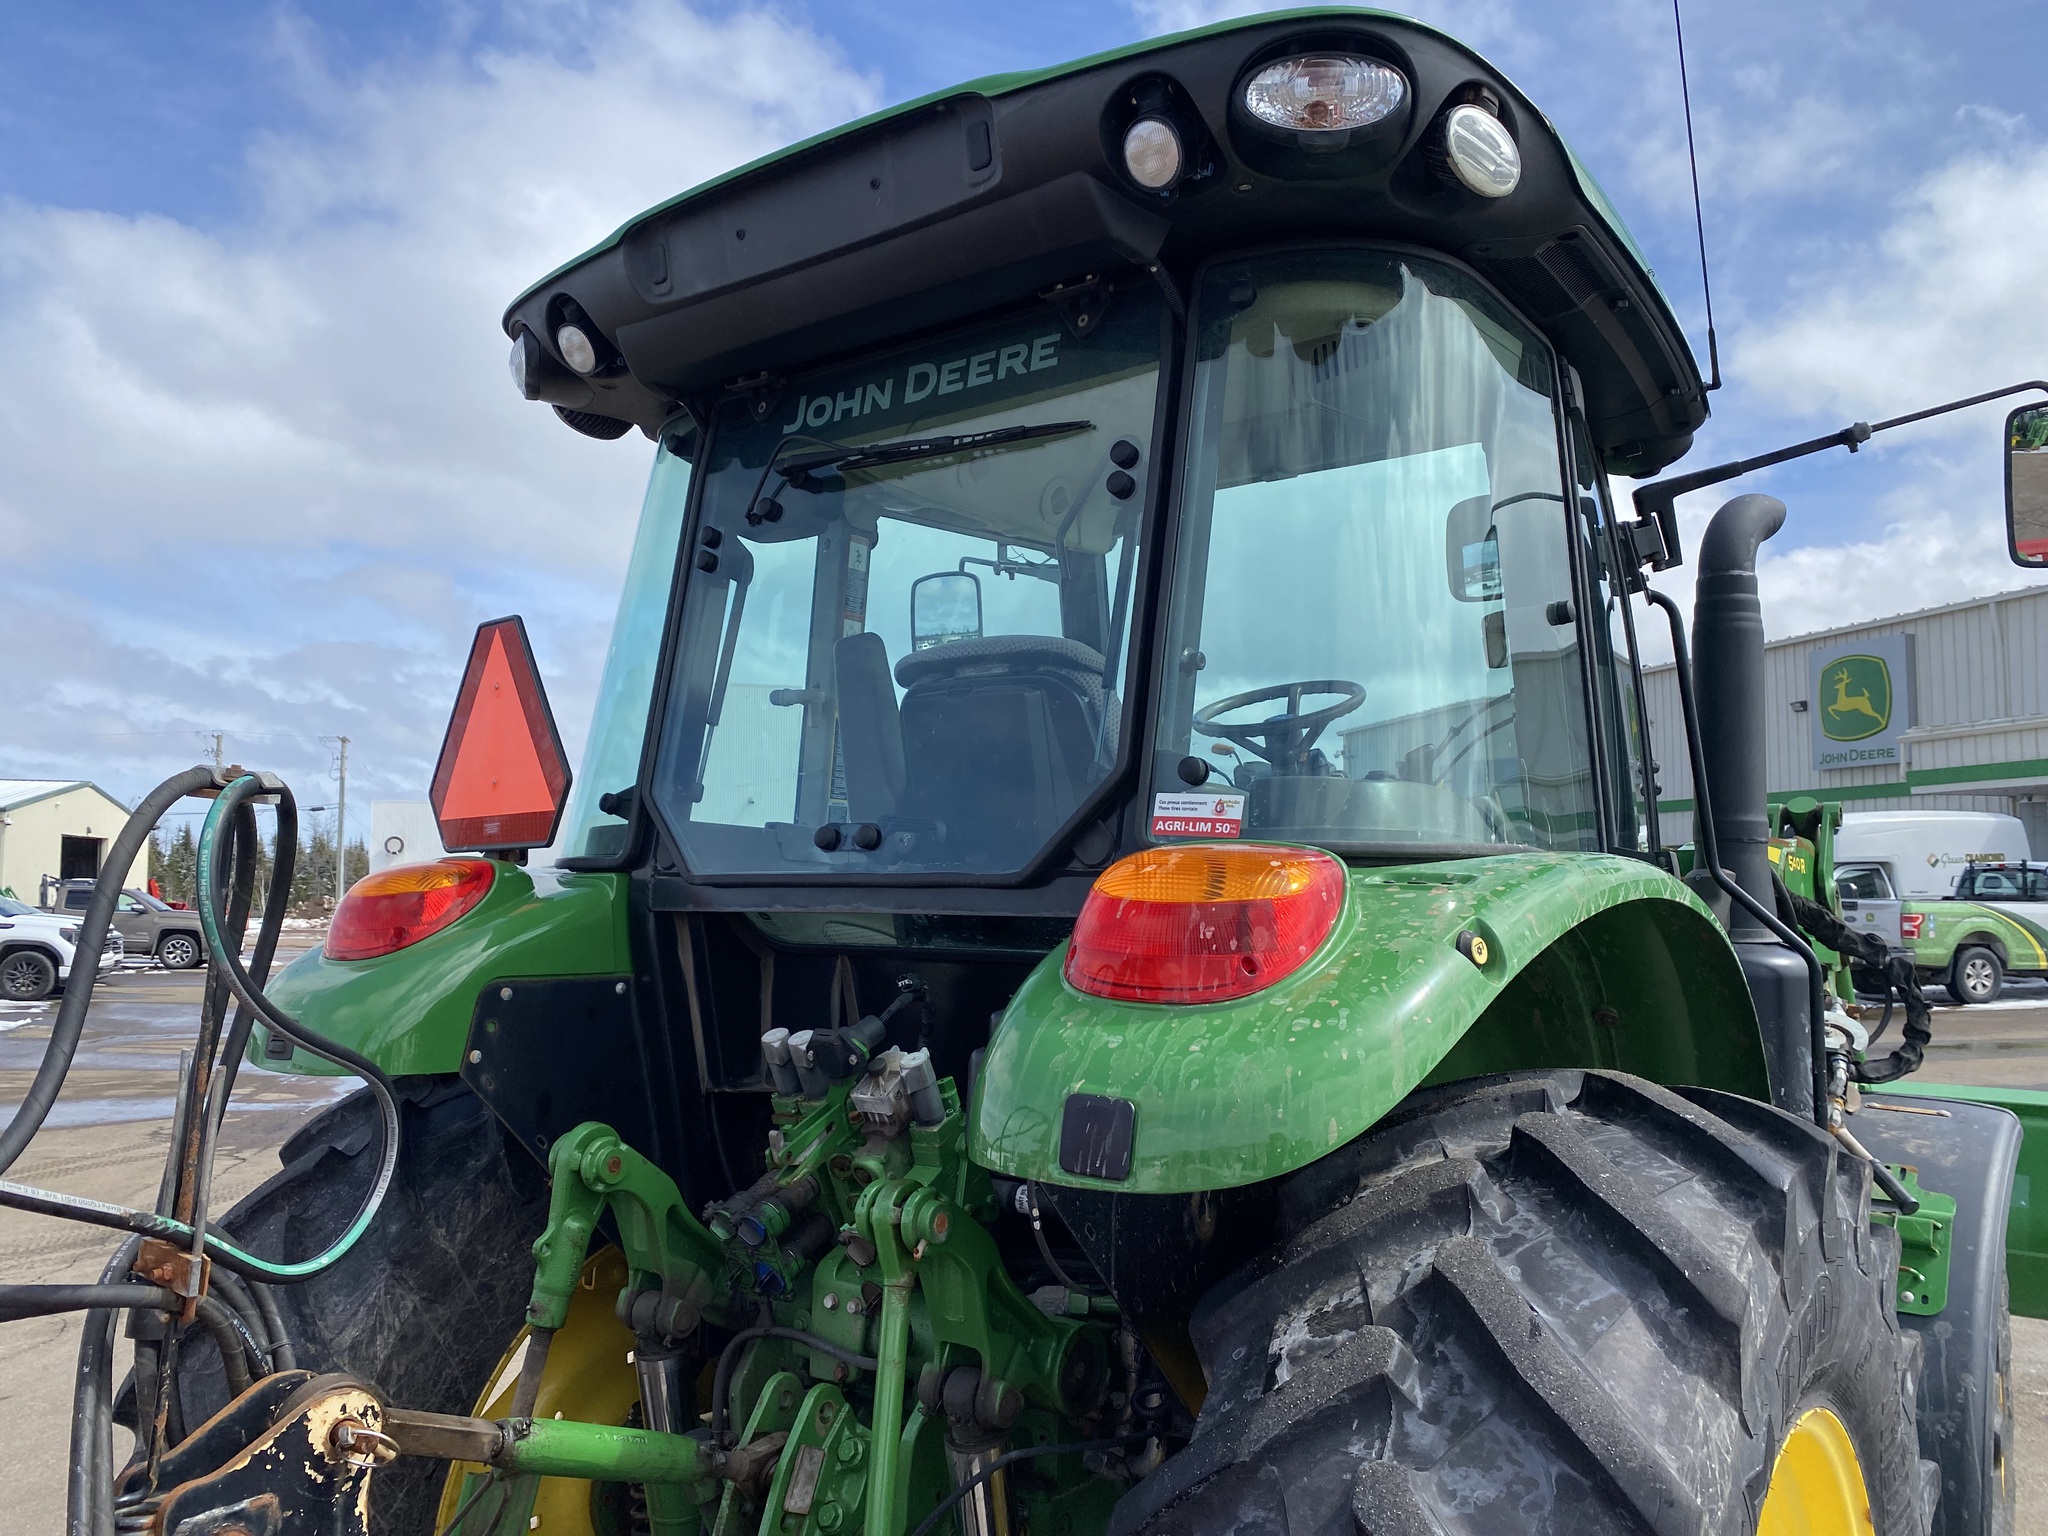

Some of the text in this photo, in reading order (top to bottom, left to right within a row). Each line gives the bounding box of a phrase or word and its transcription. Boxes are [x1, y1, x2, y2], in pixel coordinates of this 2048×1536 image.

[782, 333, 1061, 434] JOHN DEERE
[1819, 748, 1896, 765] JOHN DEERE
[1155, 820, 1231, 834] AGRI-LIM 50
